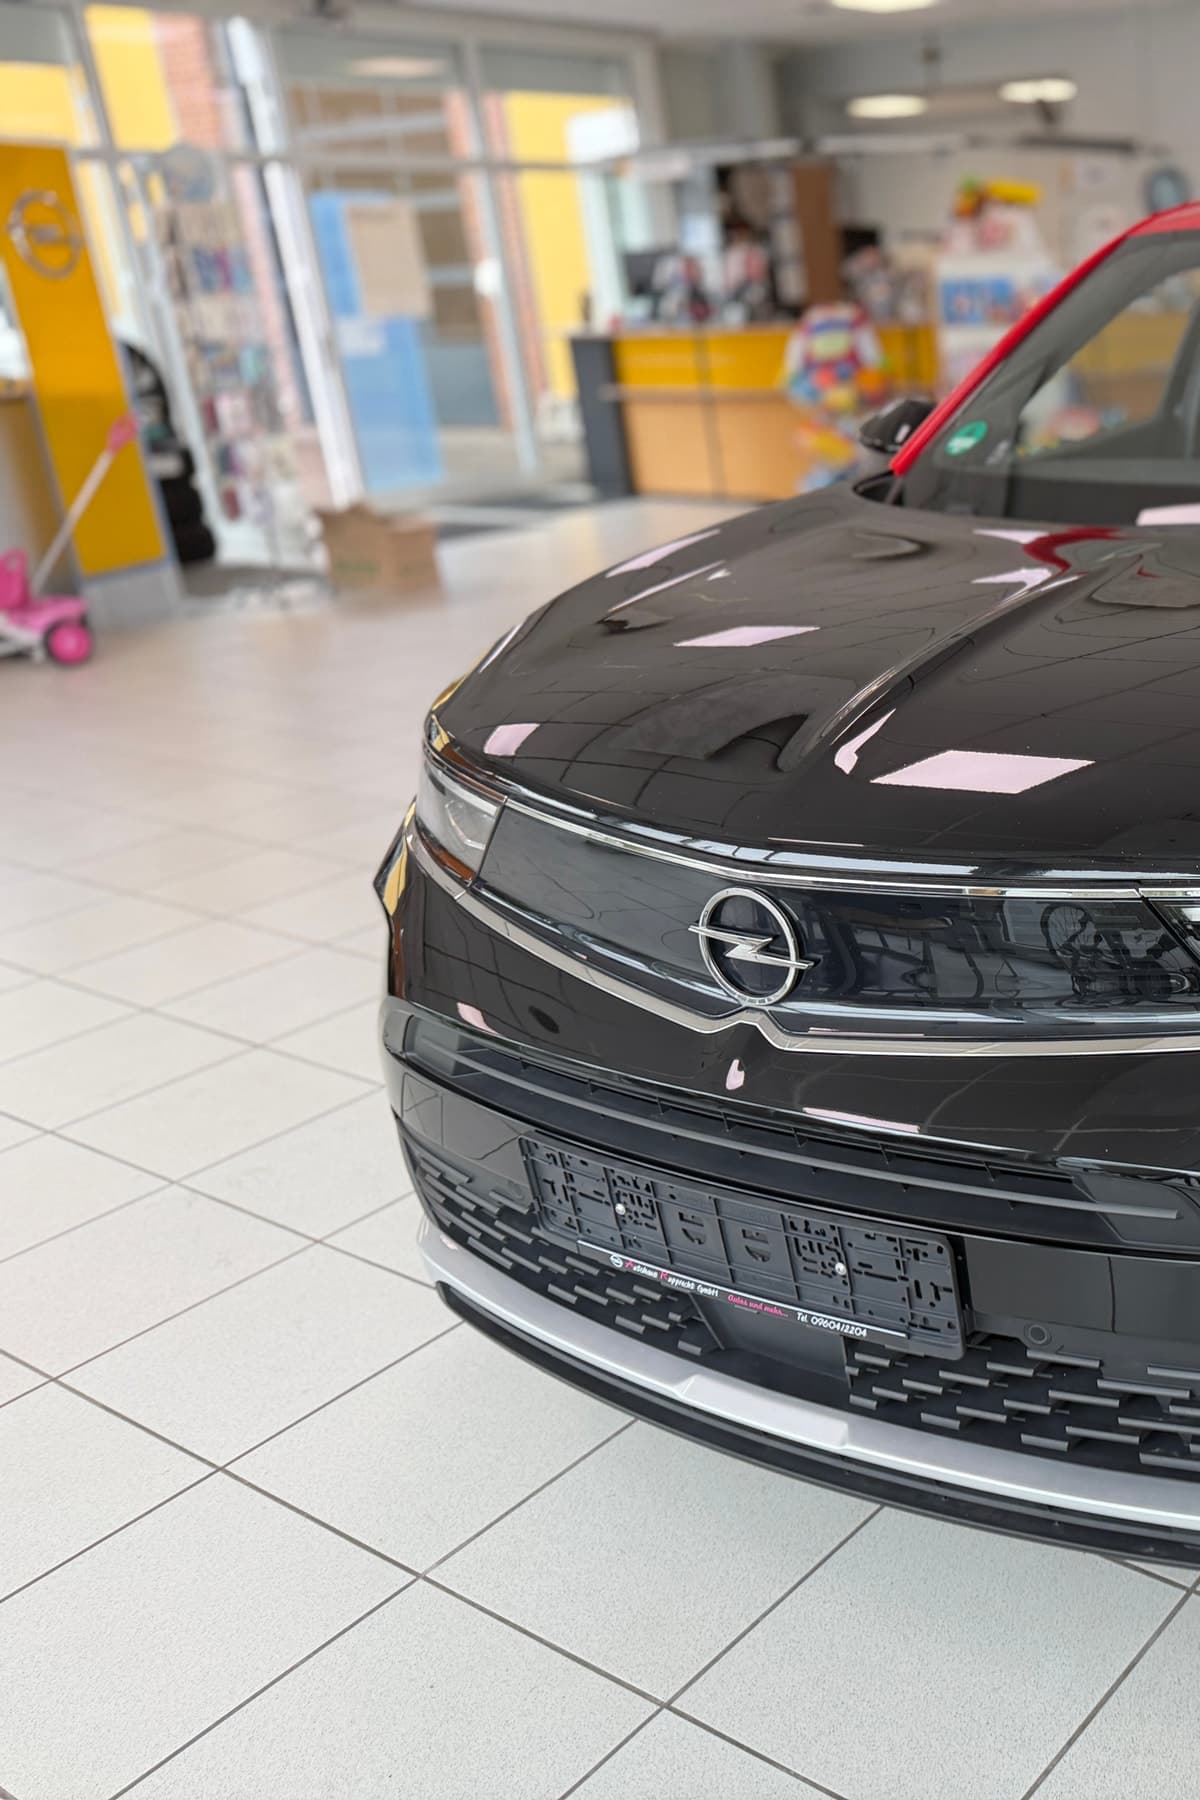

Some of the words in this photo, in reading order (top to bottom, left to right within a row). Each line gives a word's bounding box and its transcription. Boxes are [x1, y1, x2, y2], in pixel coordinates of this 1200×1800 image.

[697, 1283, 719, 1297] GmbH
[748, 1301, 764, 1311] und
[810, 1316, 868, 1338] 09604/2204
